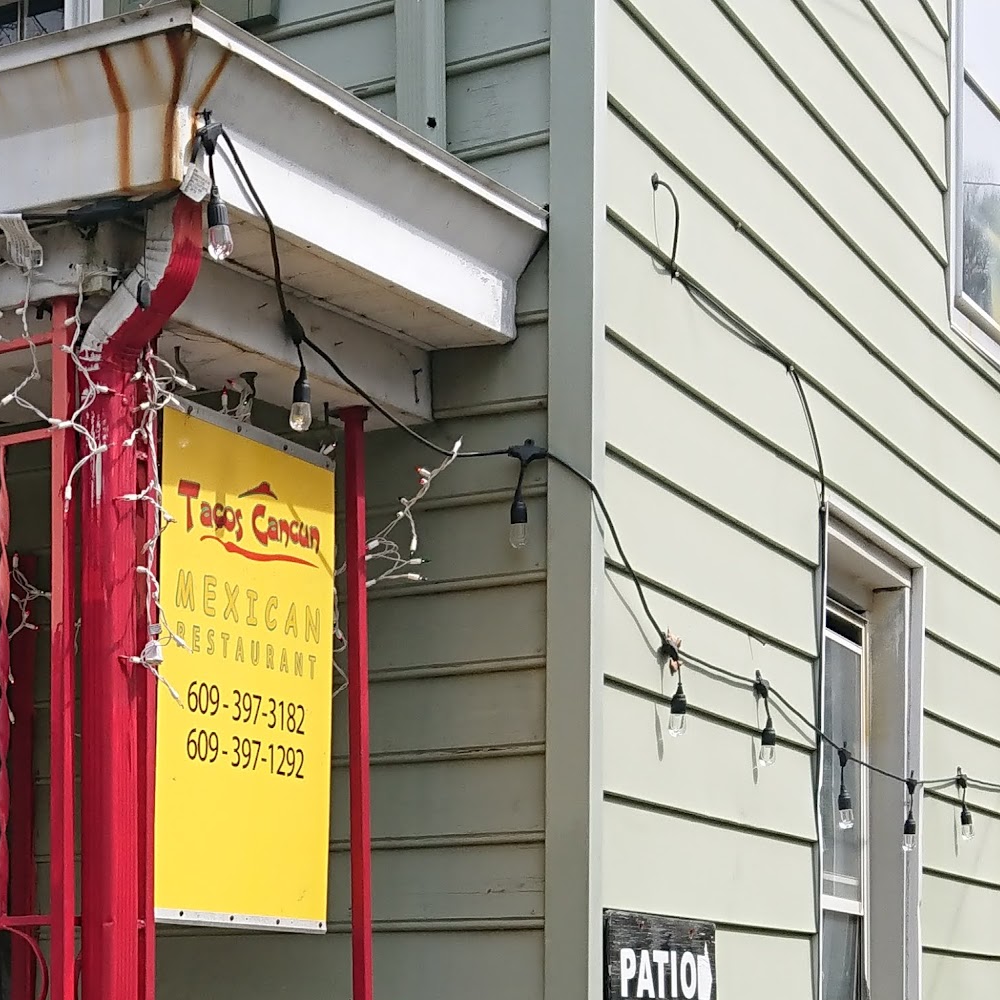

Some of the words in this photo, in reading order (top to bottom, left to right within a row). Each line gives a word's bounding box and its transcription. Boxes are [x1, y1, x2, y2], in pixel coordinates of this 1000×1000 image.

[178, 478, 243, 542] Tacos
[252, 503, 320, 554] Cancun
[175, 568, 320, 644] MEXICAN
[176, 621, 317, 680] RESTAURANT
[187, 680, 305, 735] 609-397-3182
[186, 728, 304, 779] 609-397-1292
[620, 948, 697, 999] PATIO
